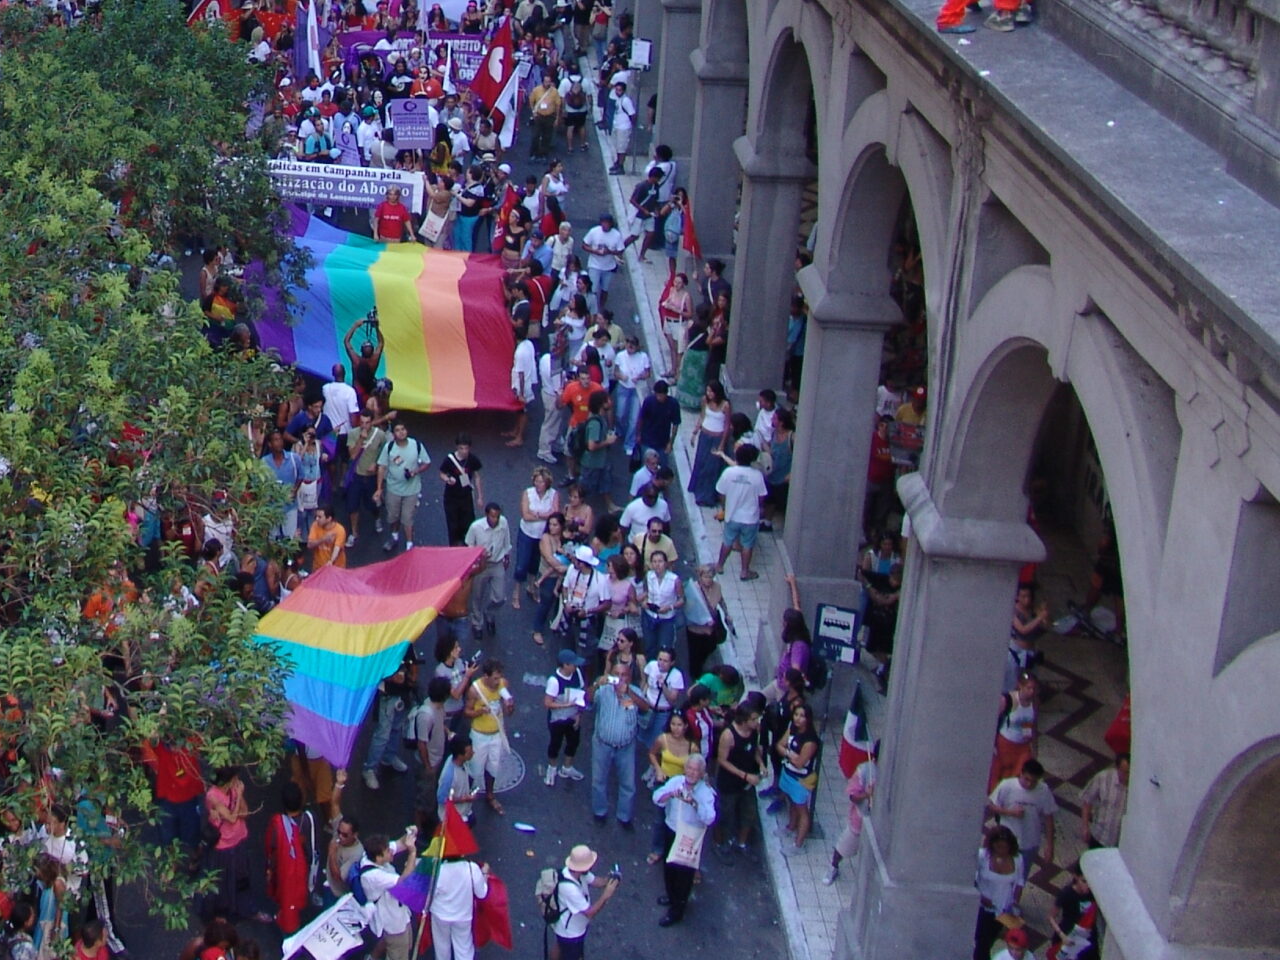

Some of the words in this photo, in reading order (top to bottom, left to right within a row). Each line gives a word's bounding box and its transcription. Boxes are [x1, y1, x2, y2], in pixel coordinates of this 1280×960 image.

[323, 165, 377, 179] Campanha
[380, 170, 402, 181] pela
[338, 180, 356, 193] do
